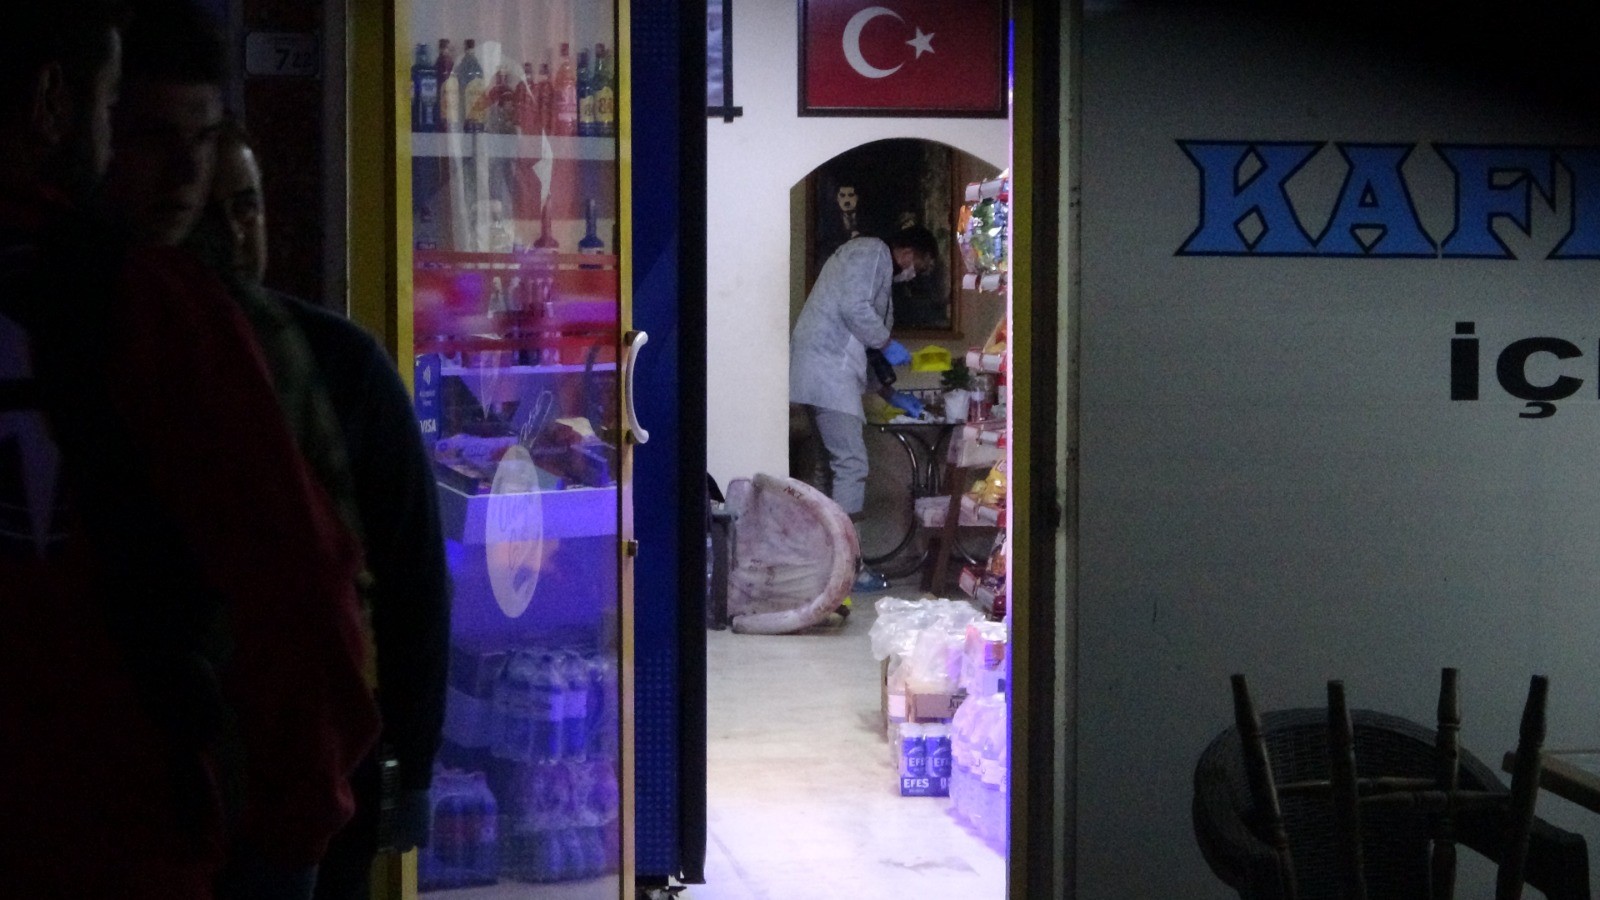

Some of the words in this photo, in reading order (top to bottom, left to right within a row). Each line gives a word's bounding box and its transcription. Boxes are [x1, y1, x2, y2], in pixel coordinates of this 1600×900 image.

[1450, 321, 1600, 419] İÇ
[419, 418, 437, 433] VISA
[903, 777, 930, 789] EFES
